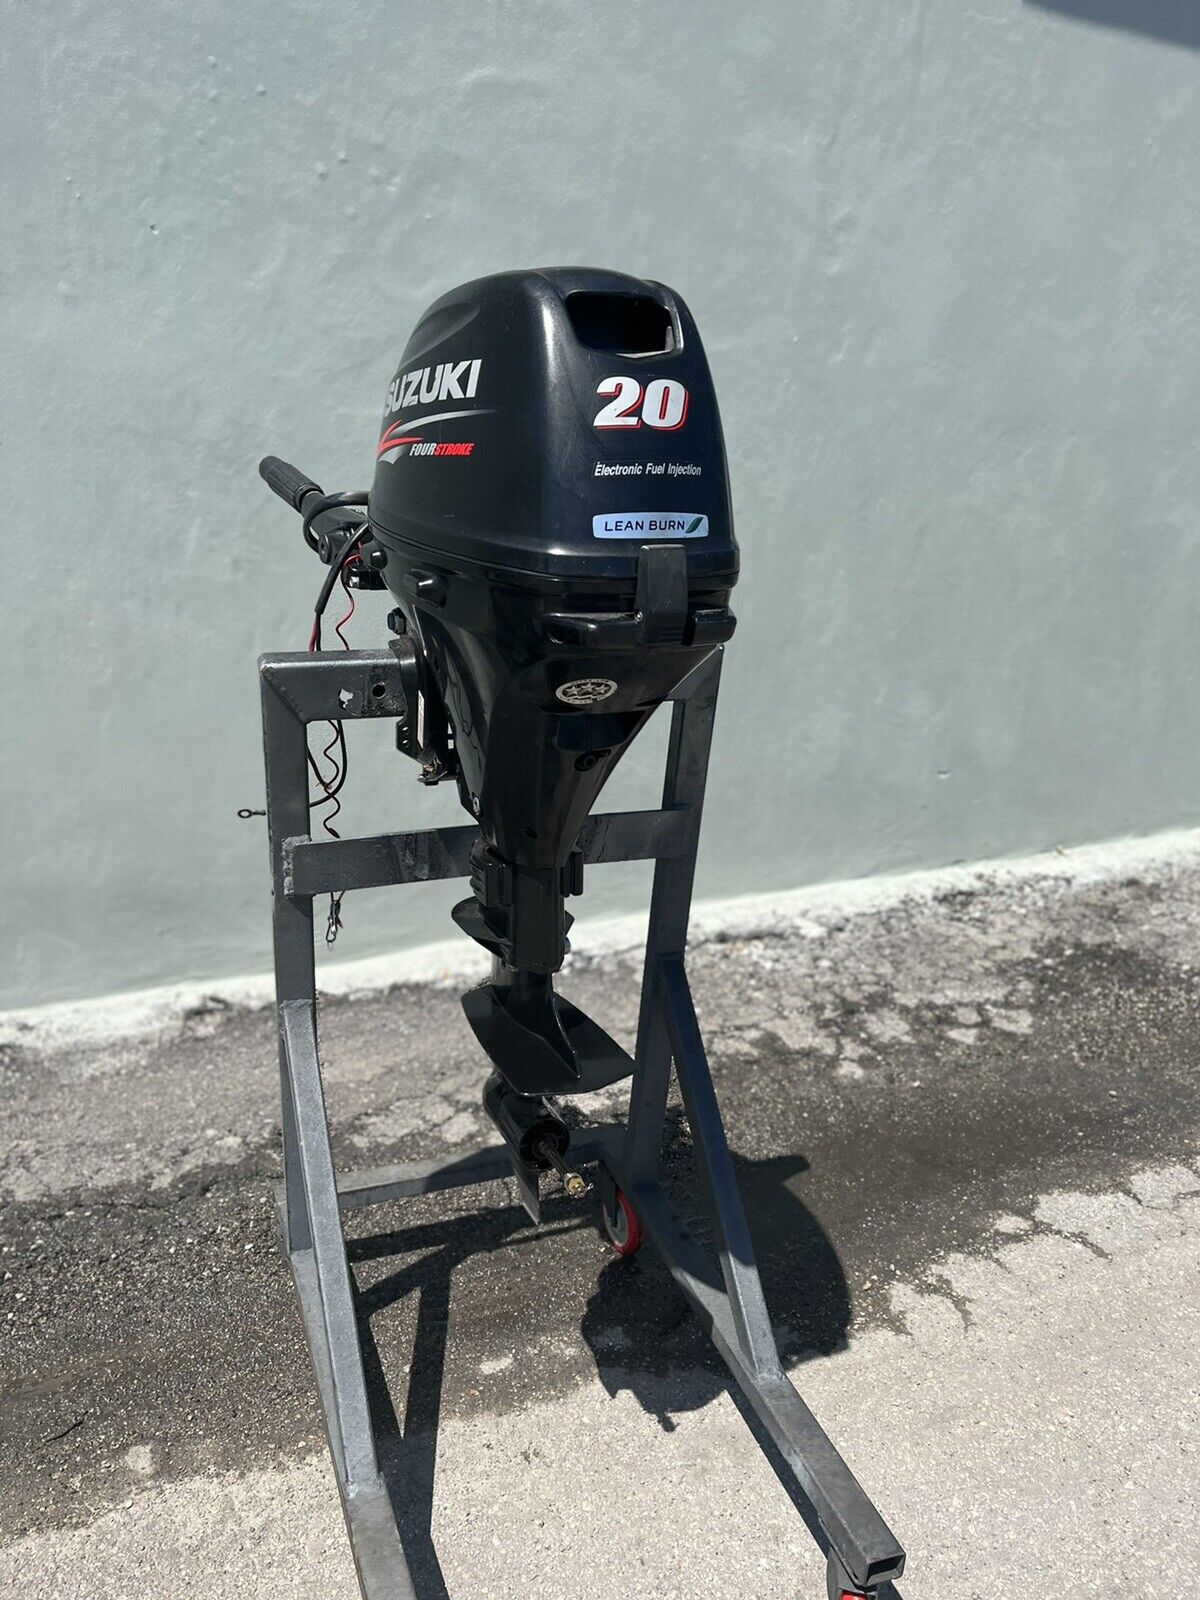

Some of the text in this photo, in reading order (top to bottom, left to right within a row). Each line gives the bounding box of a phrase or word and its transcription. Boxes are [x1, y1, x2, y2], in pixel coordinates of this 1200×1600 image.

[384, 359, 482, 418] SUZUKI
[593, 376, 690, 431] 20
[594, 462, 702, 477] Electronic Fuel Injection
[604, 520, 685, 532] LEAN BURN
